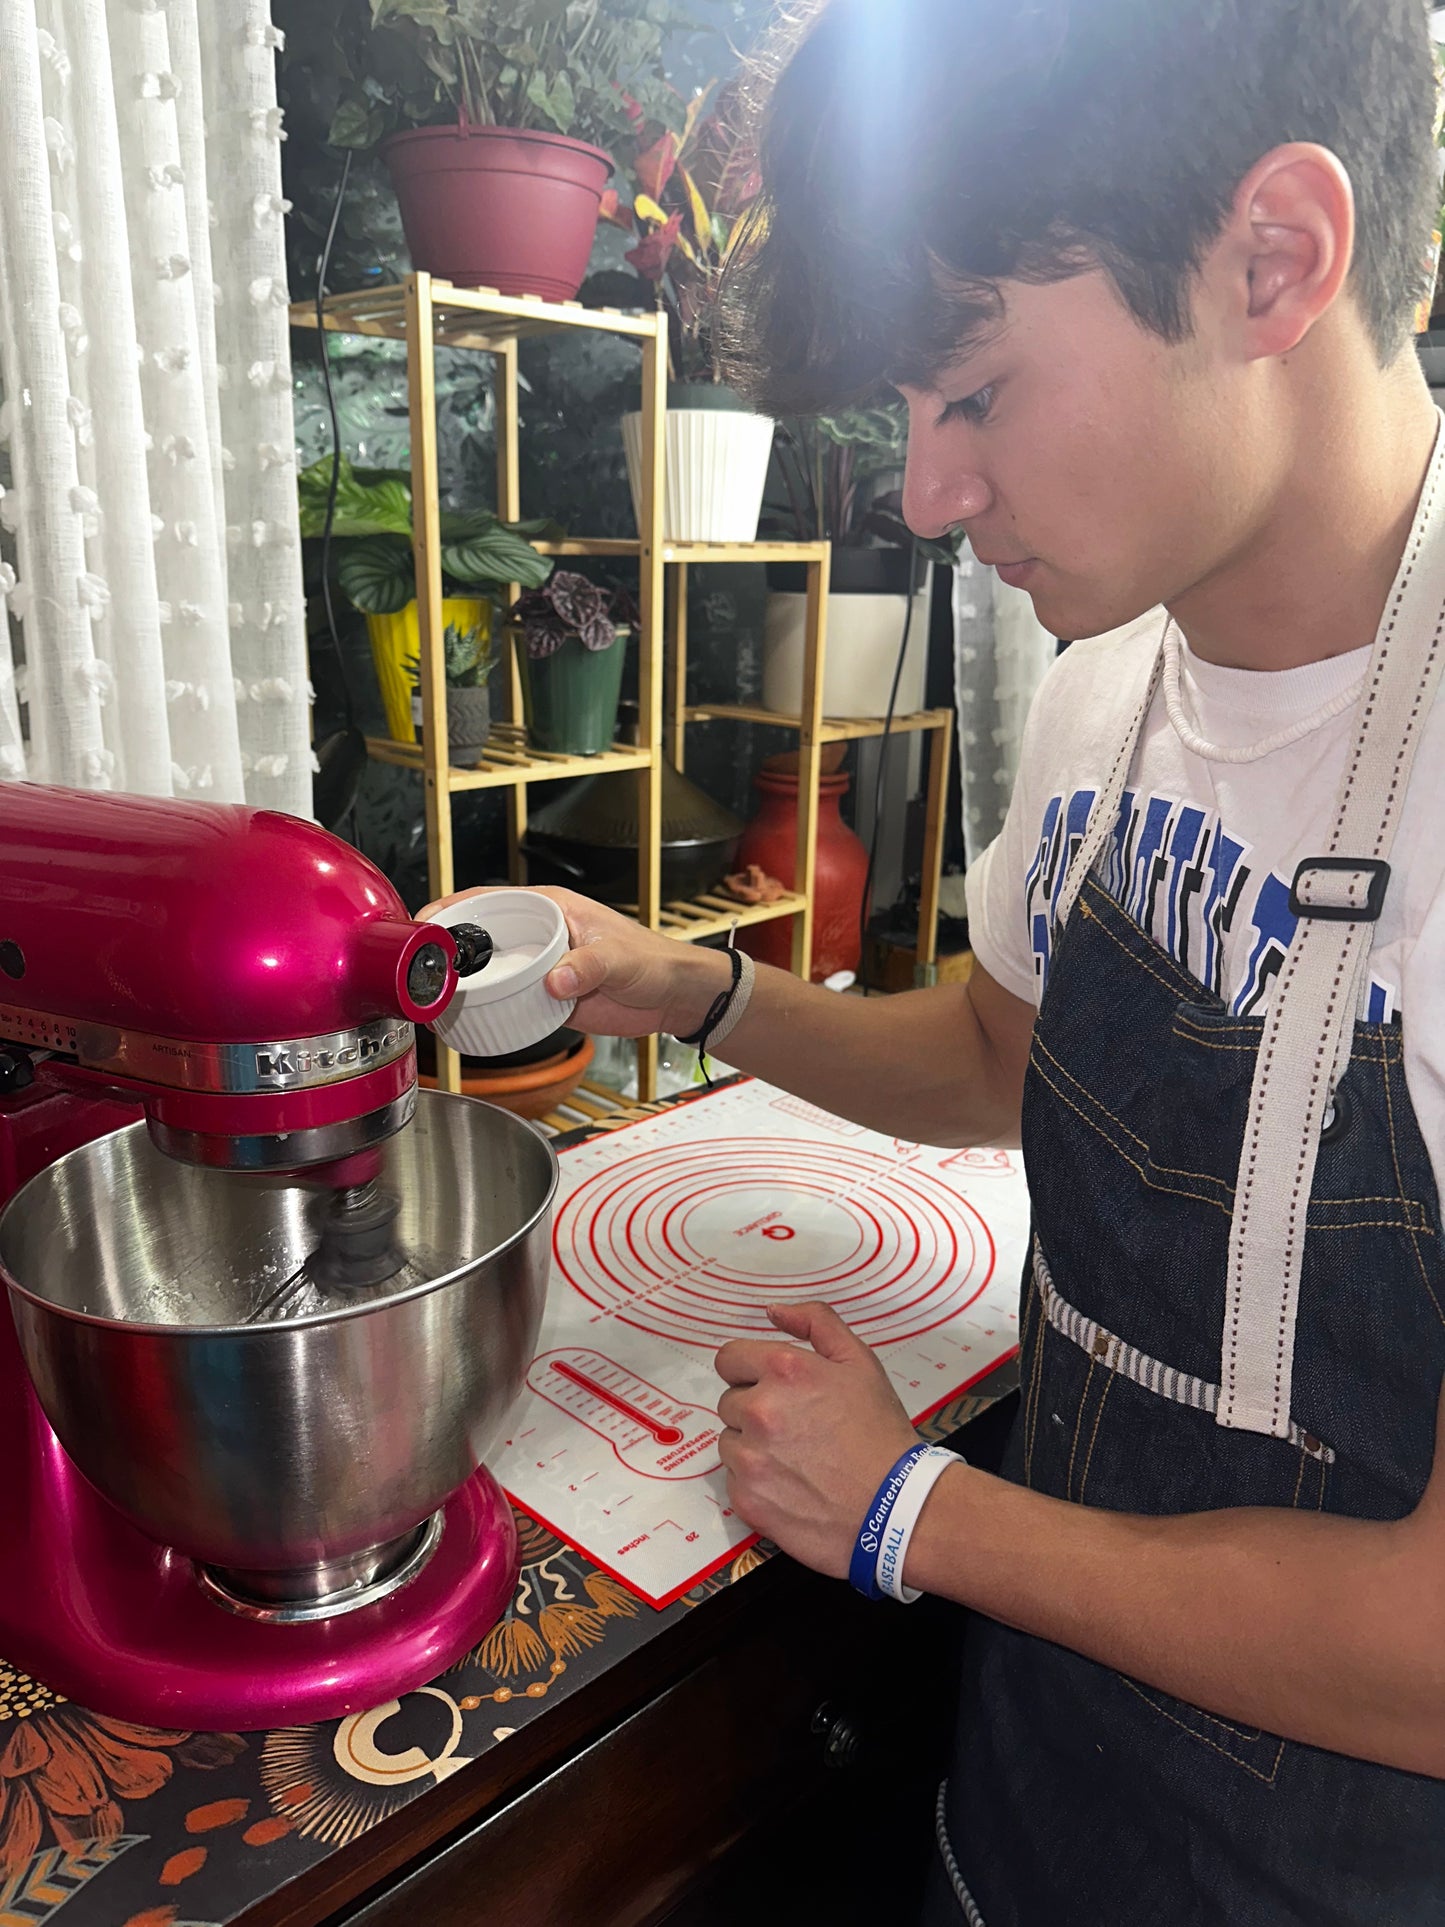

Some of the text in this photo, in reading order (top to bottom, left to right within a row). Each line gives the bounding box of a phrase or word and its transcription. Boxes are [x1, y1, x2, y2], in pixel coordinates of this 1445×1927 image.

[17, 1015, 22, 1025] 2
[28, 1018, 34, 1028] 4
[41, 1021, 47, 1031] 6
[54, 1023, 60, 1034] 8
[66, 1026, 76, 1037] 10
[152, 1043, 192, 1059] ARTISAN
[935, 1361, 947, 1371] 12
[908, 1379, 920, 1390] 13
[504, 1439, 513, 1447] 4
[656, 1428, 716, 1466] TEMPERATURES
[664, 1433, 720, 1472] ANDY MAKING
[536, 1461, 545, 1469] 3
[568, 1484, 577, 1493] 2
[869, 1460, 914, 1533] Canterbury
[602, 1508, 611, 1517] 1
[684, 1531, 700, 1544] 20
[617, 1533, 650, 1557] inches
